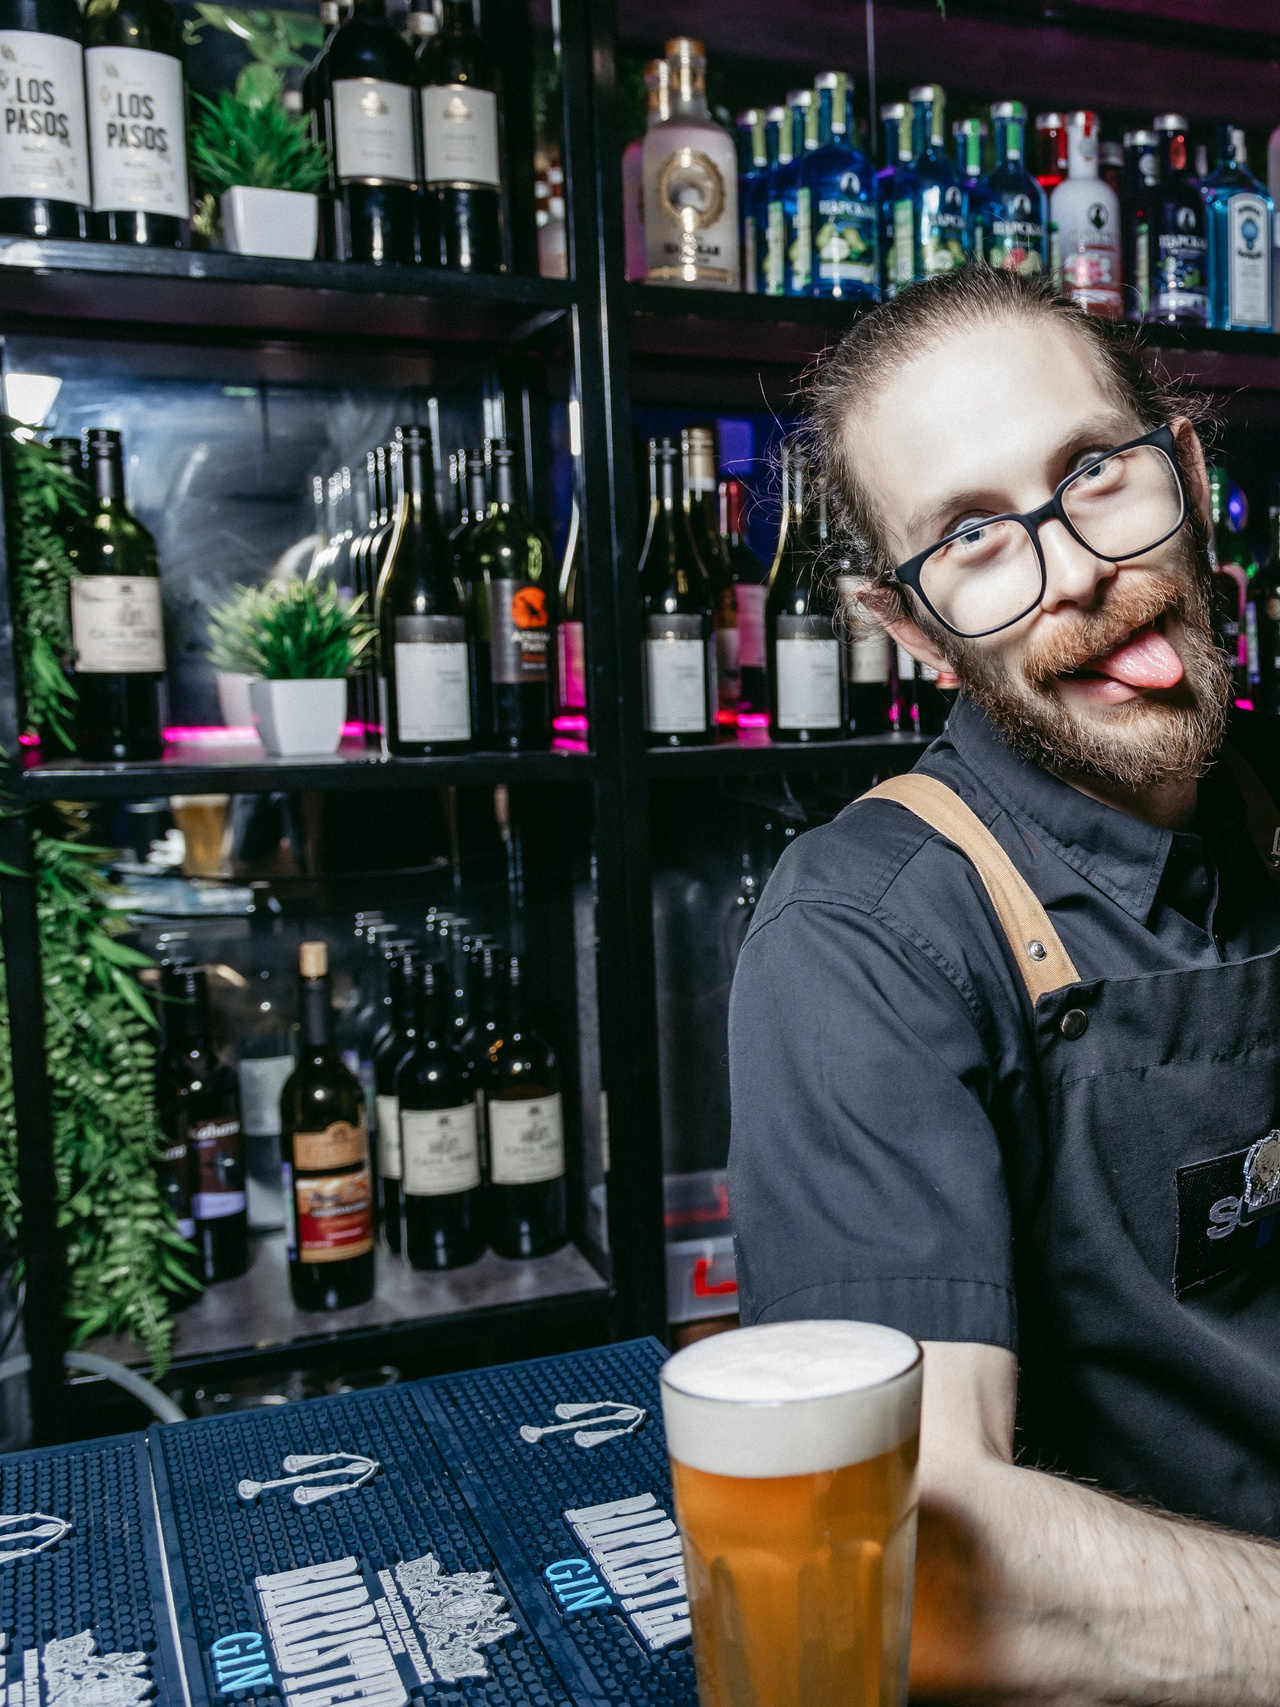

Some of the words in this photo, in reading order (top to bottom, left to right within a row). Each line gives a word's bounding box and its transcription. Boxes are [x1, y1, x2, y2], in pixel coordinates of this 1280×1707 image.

[16, 77, 55, 106] LOS
[117, 92, 155, 120] LOS
[5, 108, 70, 139] PASOS
[106, 123, 168, 152] PASOS
[545, 1558, 613, 1612] GIN
[212, 1631, 274, 1693] GIN
